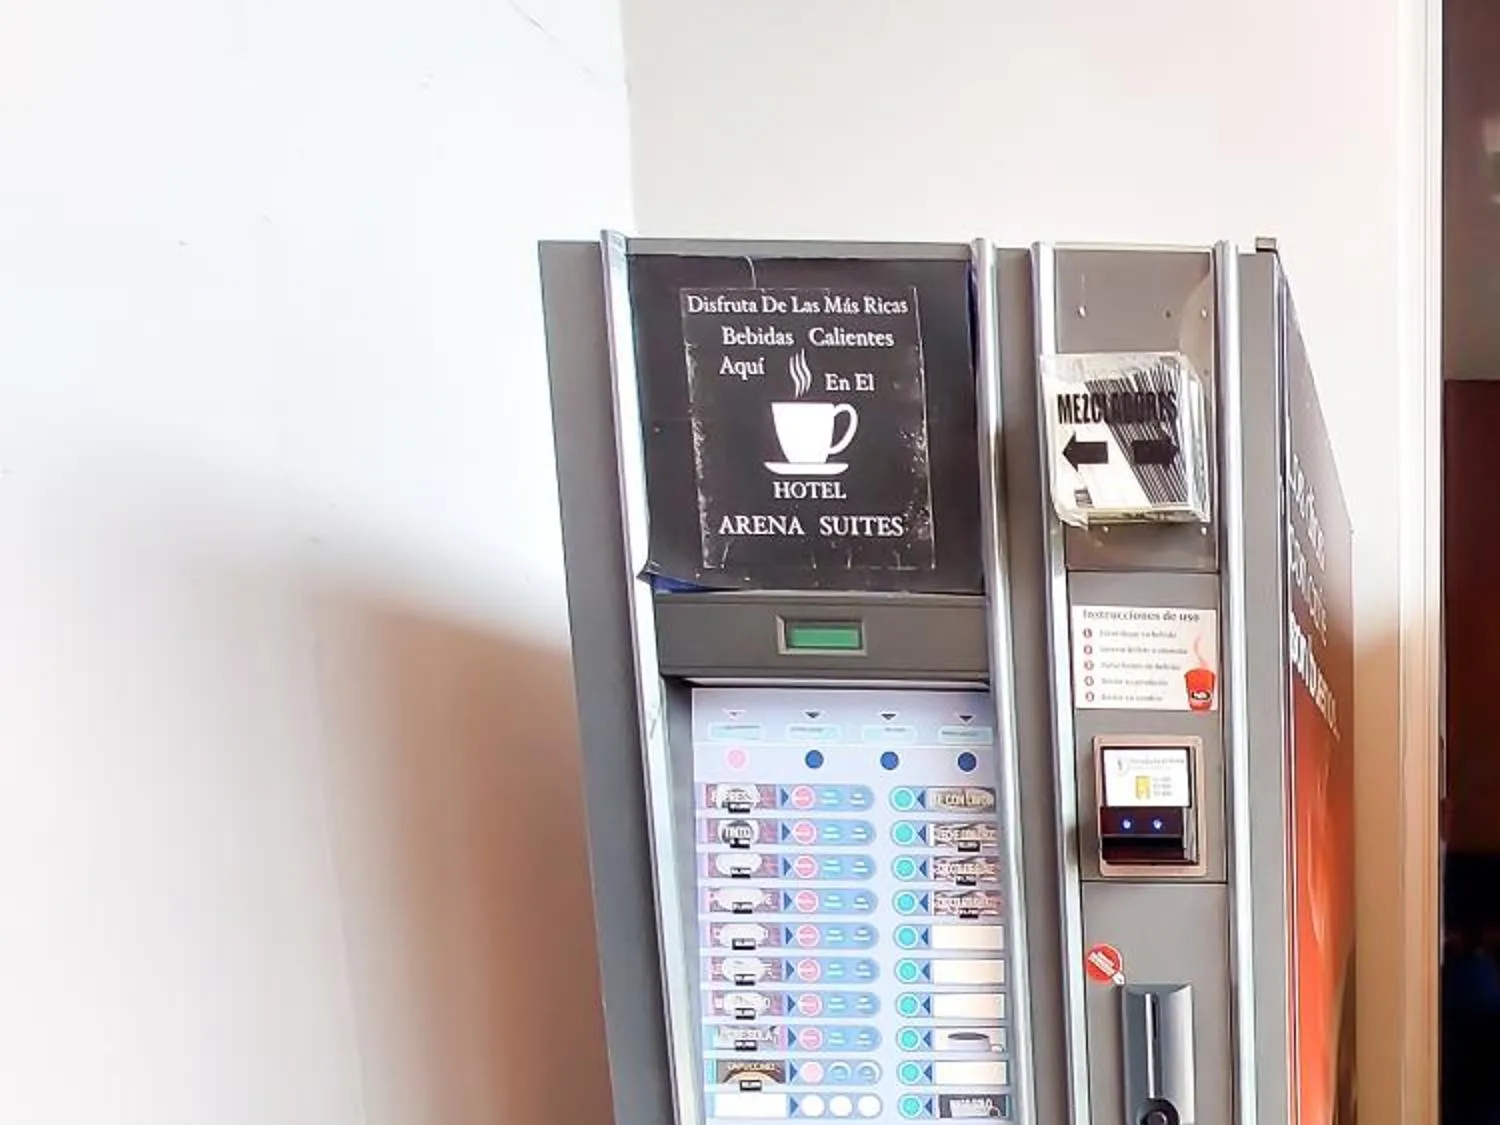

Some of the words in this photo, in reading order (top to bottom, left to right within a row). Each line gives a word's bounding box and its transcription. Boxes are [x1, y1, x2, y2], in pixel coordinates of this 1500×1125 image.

[687, 296, 757, 314] Disfruta
[762, 296, 788, 314] De
[792, 297, 820, 314] Las
[824, 297, 859, 314] Más
[865, 297, 908, 314] Ricas
[722, 328, 794, 346] Bebidas
[809, 328, 894, 347] Calientes
[719, 356, 766, 379] Aquí
[825, 373, 850, 391] En
[855, 373, 875, 391] El
[773, 482, 846, 500] HOTEL
[719, 516, 804, 536] ARENA
[820, 516, 904, 537] SUITES
[1083, 608, 1161, 622] Instrucciones
[1162, 610, 1178, 622] de
[1180, 612, 1200, 624] uso
